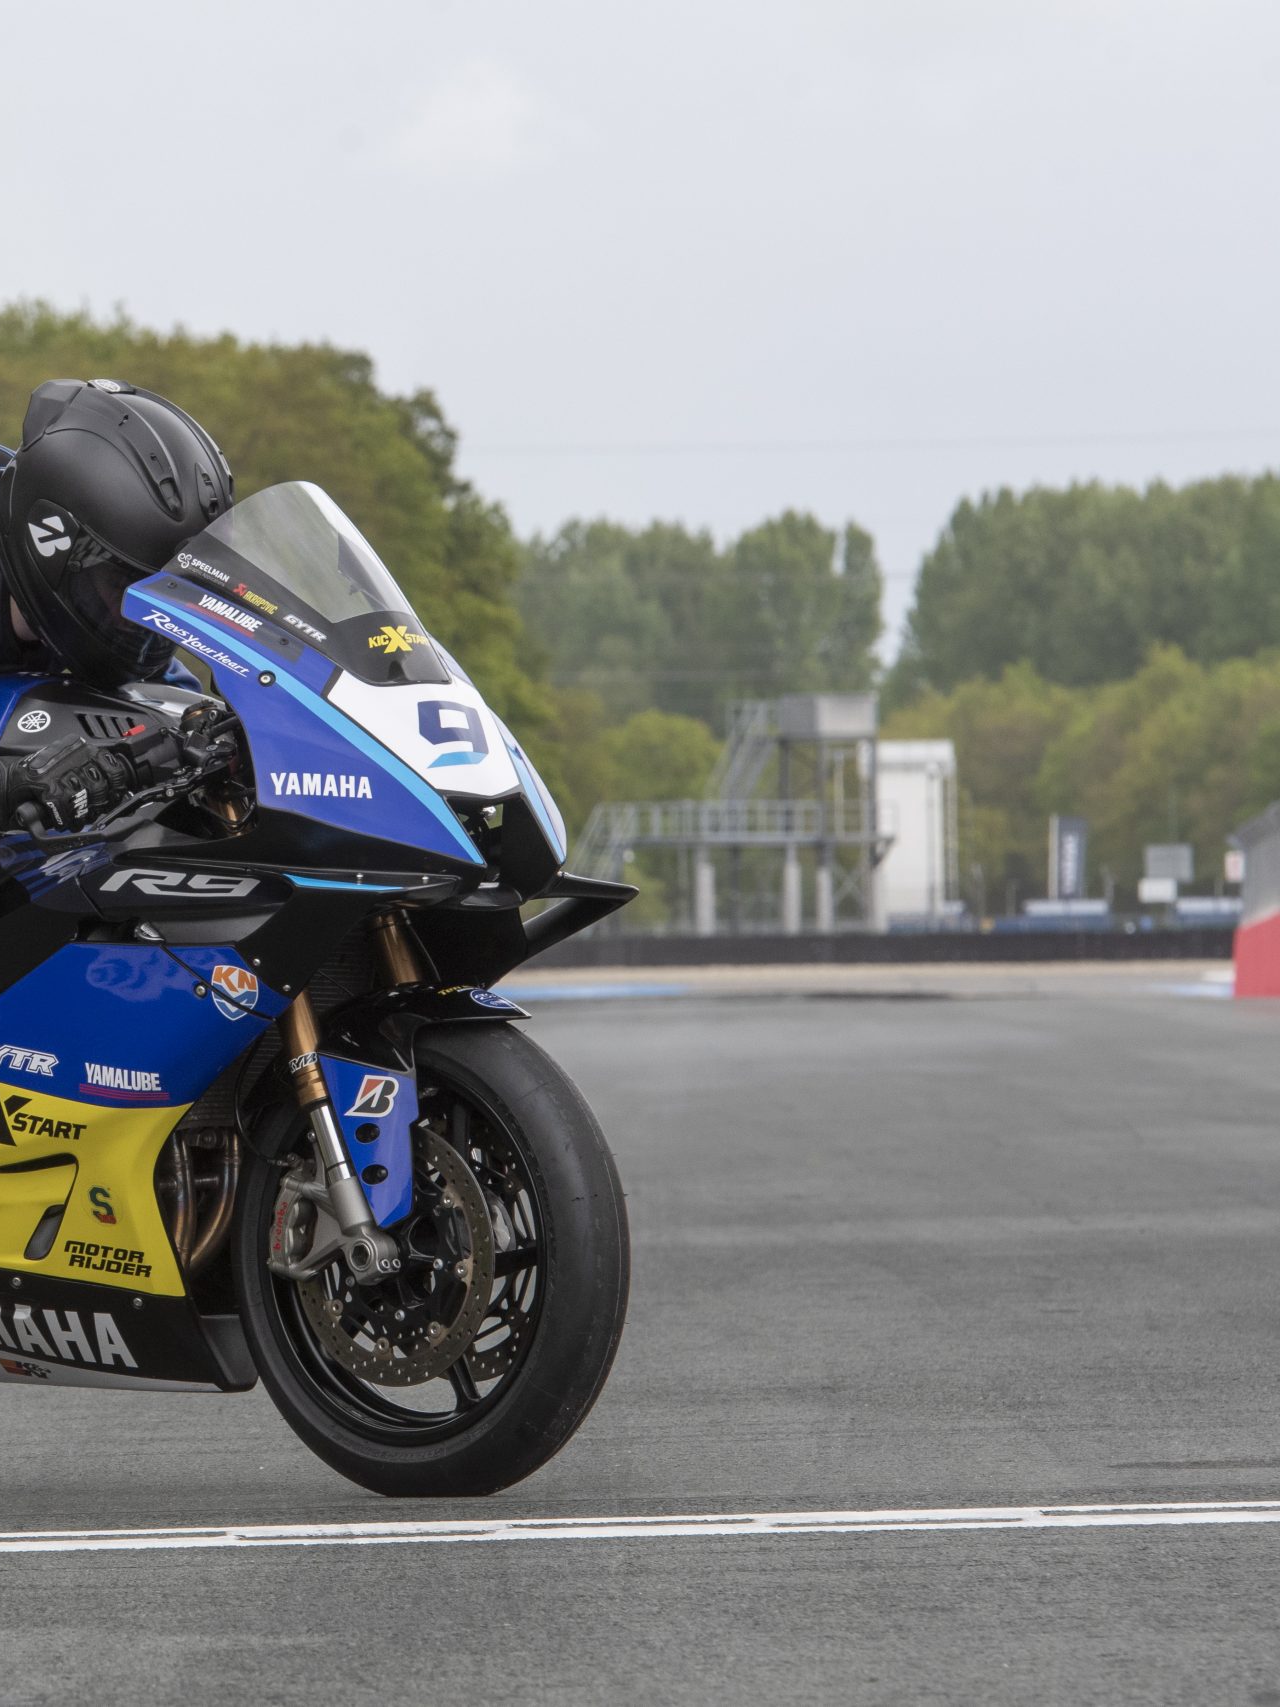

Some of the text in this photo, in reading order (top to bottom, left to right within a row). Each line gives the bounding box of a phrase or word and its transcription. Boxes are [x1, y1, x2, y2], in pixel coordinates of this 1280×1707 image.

[190, 558, 231, 583] SPEELMAN
[198, 594, 264, 633] YAMALUBE
[283, 613, 328, 643] GYTR
[142, 609, 250, 678] Revs Your Heart
[417, 700, 489, 769] 9
[270, 772, 373, 799] YAMAHA
[99, 868, 261, 897] R9
[84, 1062, 161, 1092] YAMALUBE
[272, 1201, 289, 1252] brembo
[64, 1240, 145, 1263] MOTOR
[68, 1254, 152, 1277] RIJDER
